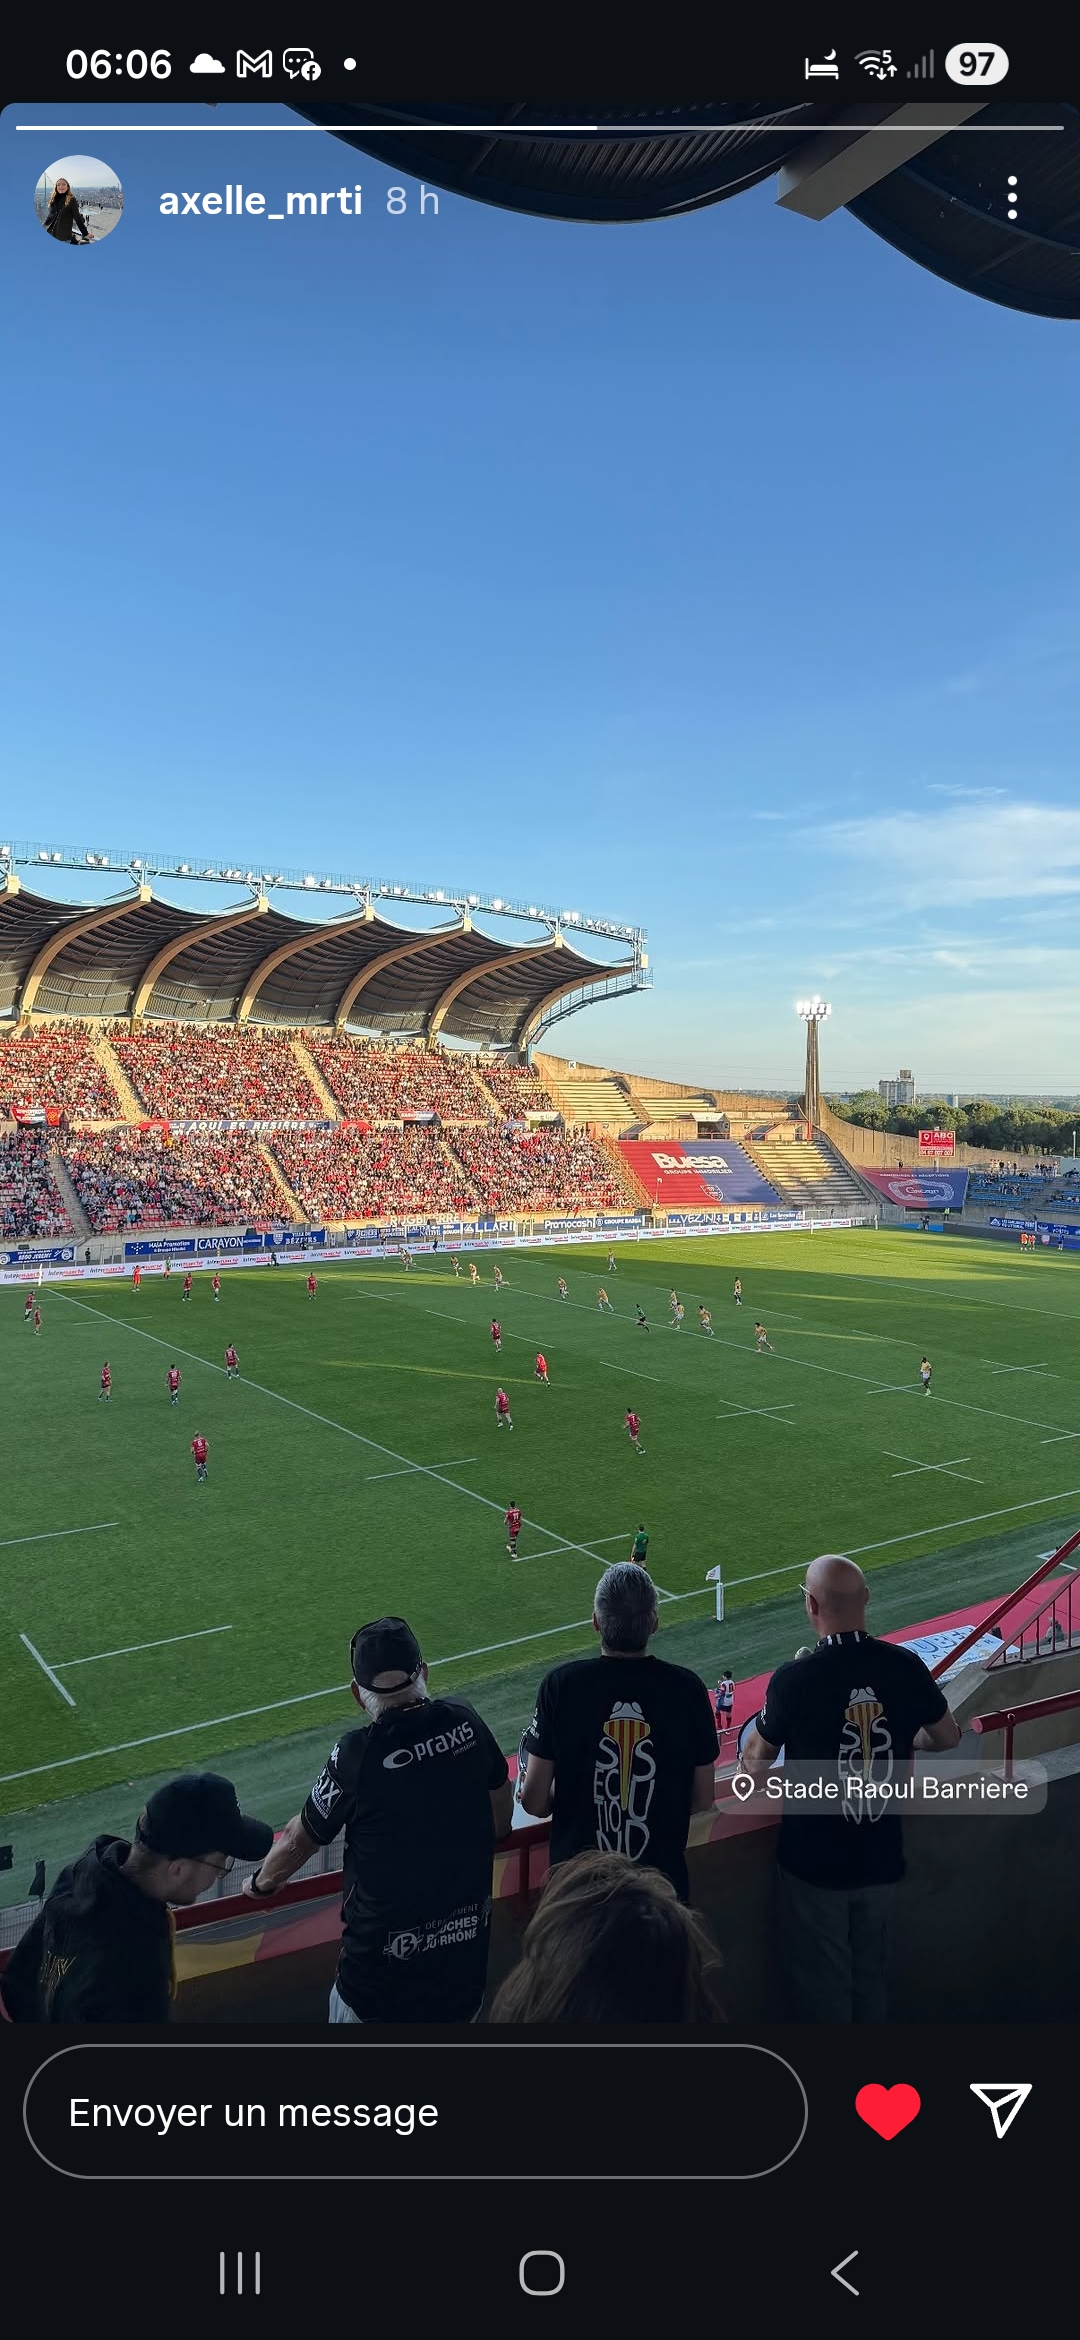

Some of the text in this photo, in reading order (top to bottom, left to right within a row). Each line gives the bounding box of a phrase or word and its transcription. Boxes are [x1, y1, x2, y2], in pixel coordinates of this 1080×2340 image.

[651, 1153, 728, 1169] Buesa
[545, 1218, 593, 1230] Promocash
[198, 1237, 243, 1250] CARAYON
[413, 1720, 474, 1762] praxis
